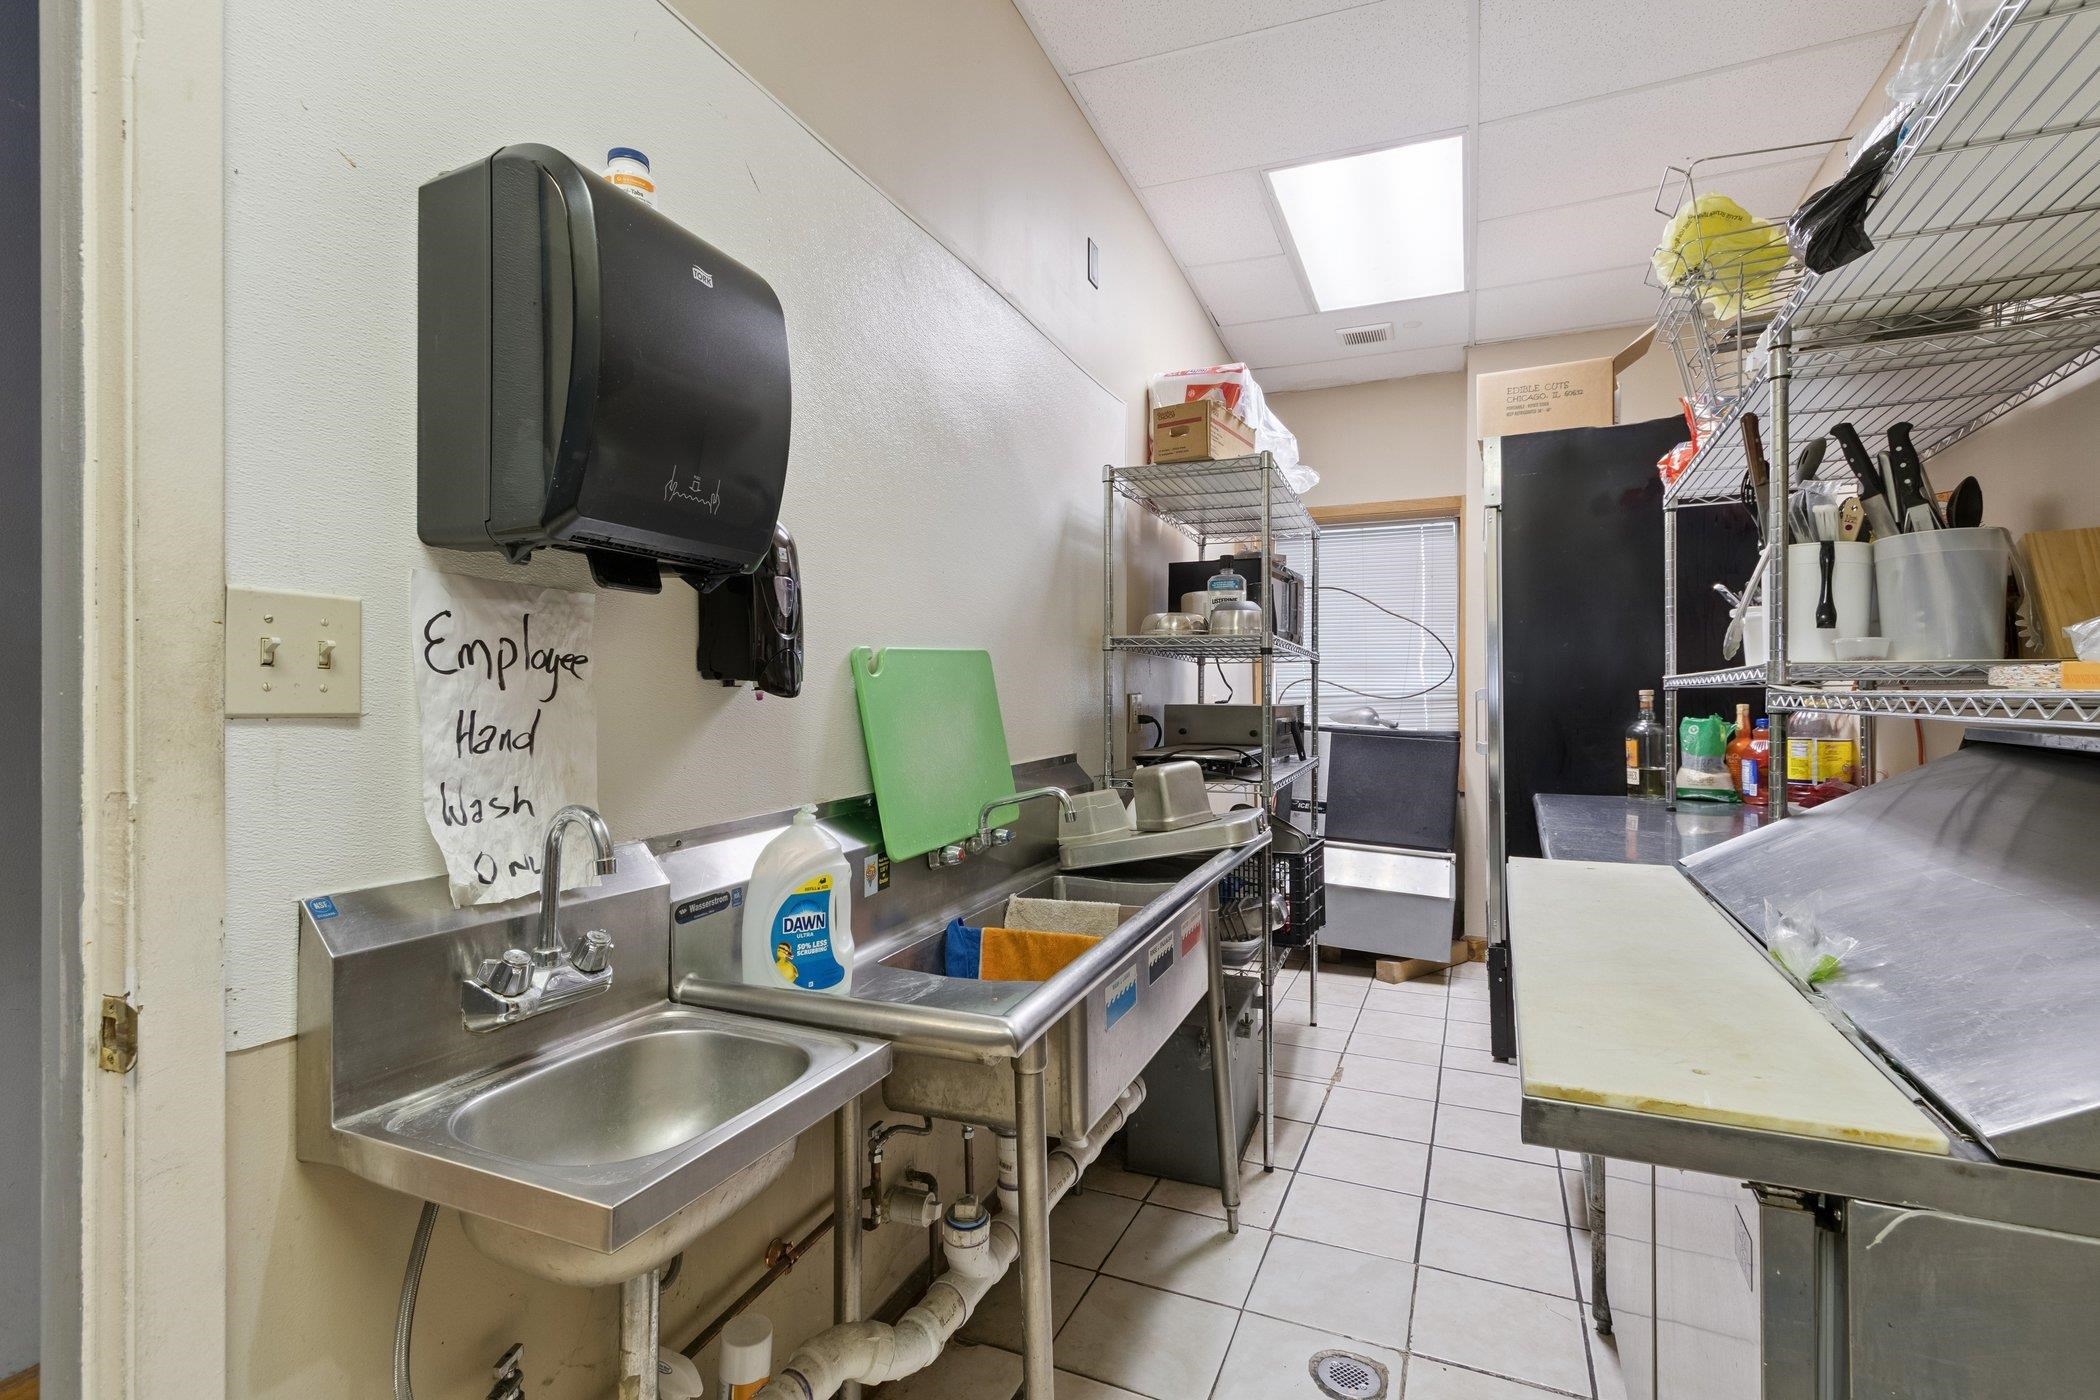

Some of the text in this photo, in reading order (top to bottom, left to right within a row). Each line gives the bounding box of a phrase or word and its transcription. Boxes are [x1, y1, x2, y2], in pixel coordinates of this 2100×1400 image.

[694, 268, 713, 288] TORK
[1506, 380, 1570, 395] EDIBLE CUTS
[423, 609, 589, 703] Employee
[456, 708, 541, 759] Hand
[440, 781, 535, 827] Wash
[689, 894, 729, 913] Wasserstrom
[783, 913, 826, 934] DAWN
[796, 939, 828, 951] 50% LESS
